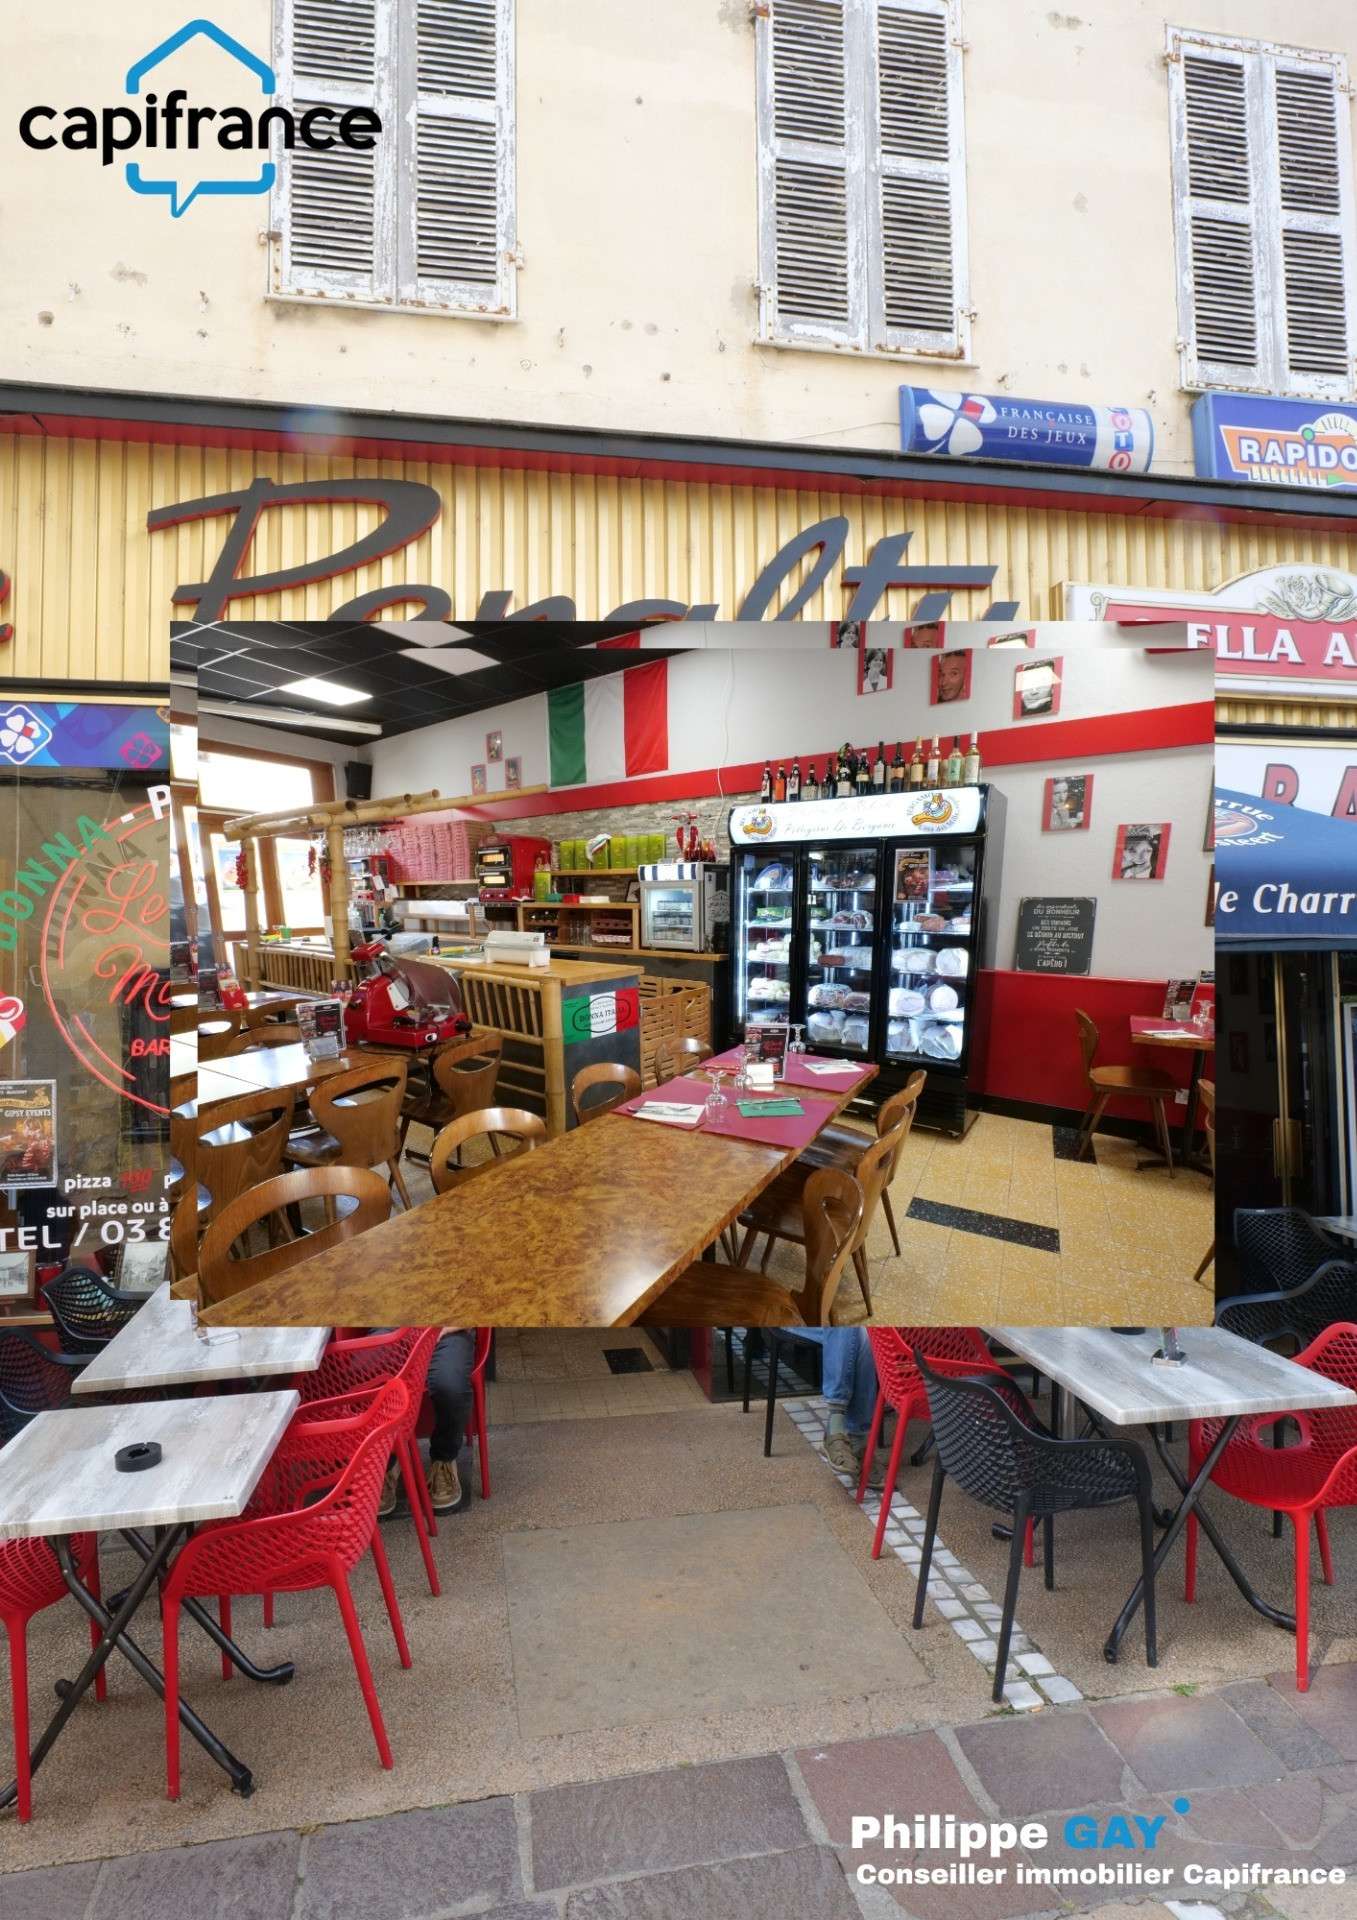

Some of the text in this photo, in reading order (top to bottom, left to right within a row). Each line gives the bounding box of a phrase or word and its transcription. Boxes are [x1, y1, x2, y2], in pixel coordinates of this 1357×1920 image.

[1001, 407, 1093, 425] FRANÇAISE
[1008, 425, 1086, 445] DES JEUX
[1239, 430, 1357, 471] RAPIDO
[64, 1173, 112, 1193] pizza
[46, 1197, 169, 1219] sur place ou à
